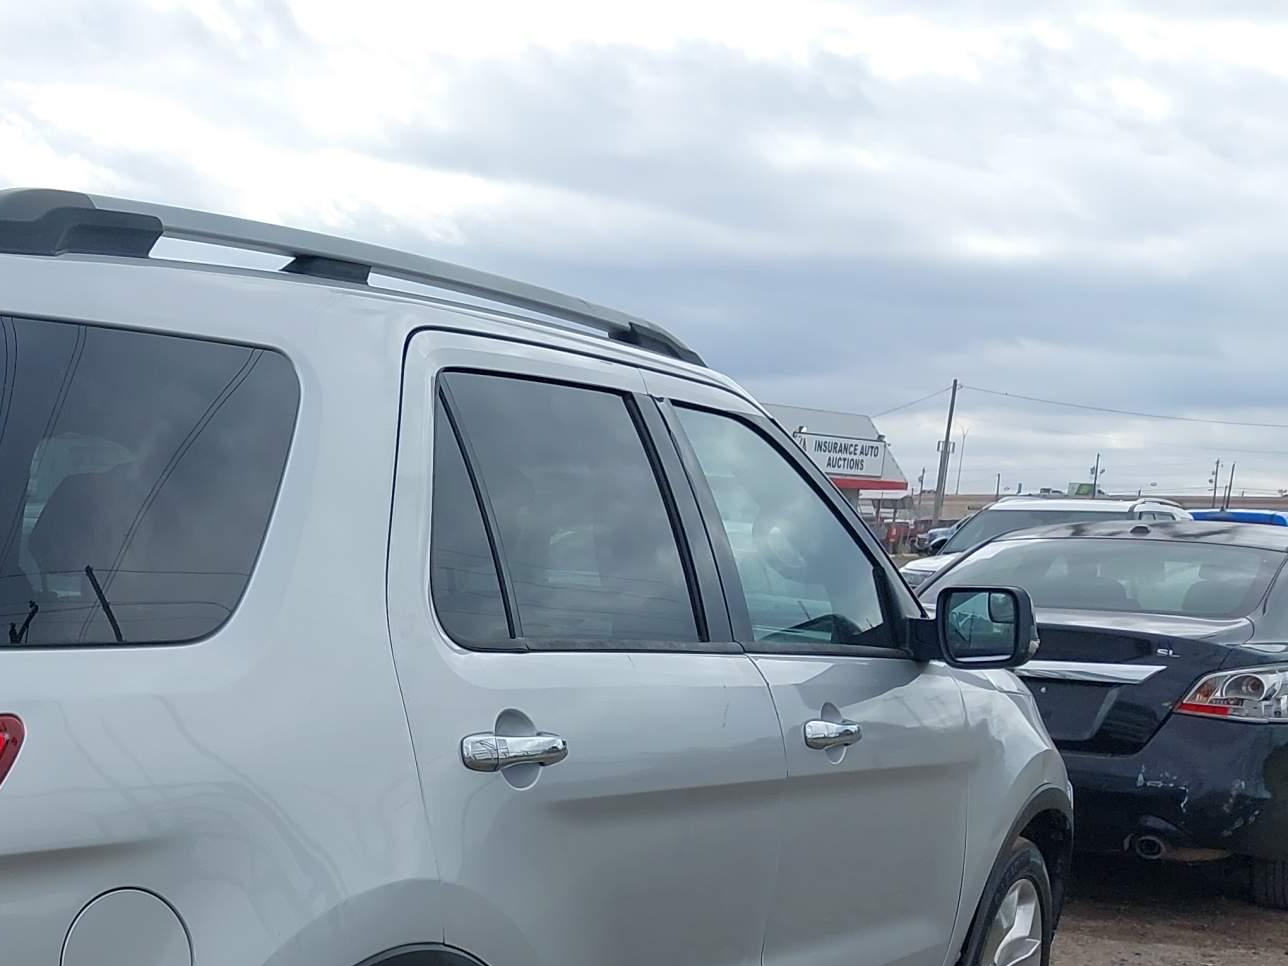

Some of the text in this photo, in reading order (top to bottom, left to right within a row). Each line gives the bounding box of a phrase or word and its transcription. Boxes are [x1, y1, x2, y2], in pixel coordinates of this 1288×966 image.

[814, 440, 859, 456] INSURANCE
[860, 445, 879, 458] AUTO
[826, 456, 865, 471] AUCTIONS
[1156, 648, 1181, 658] SL
